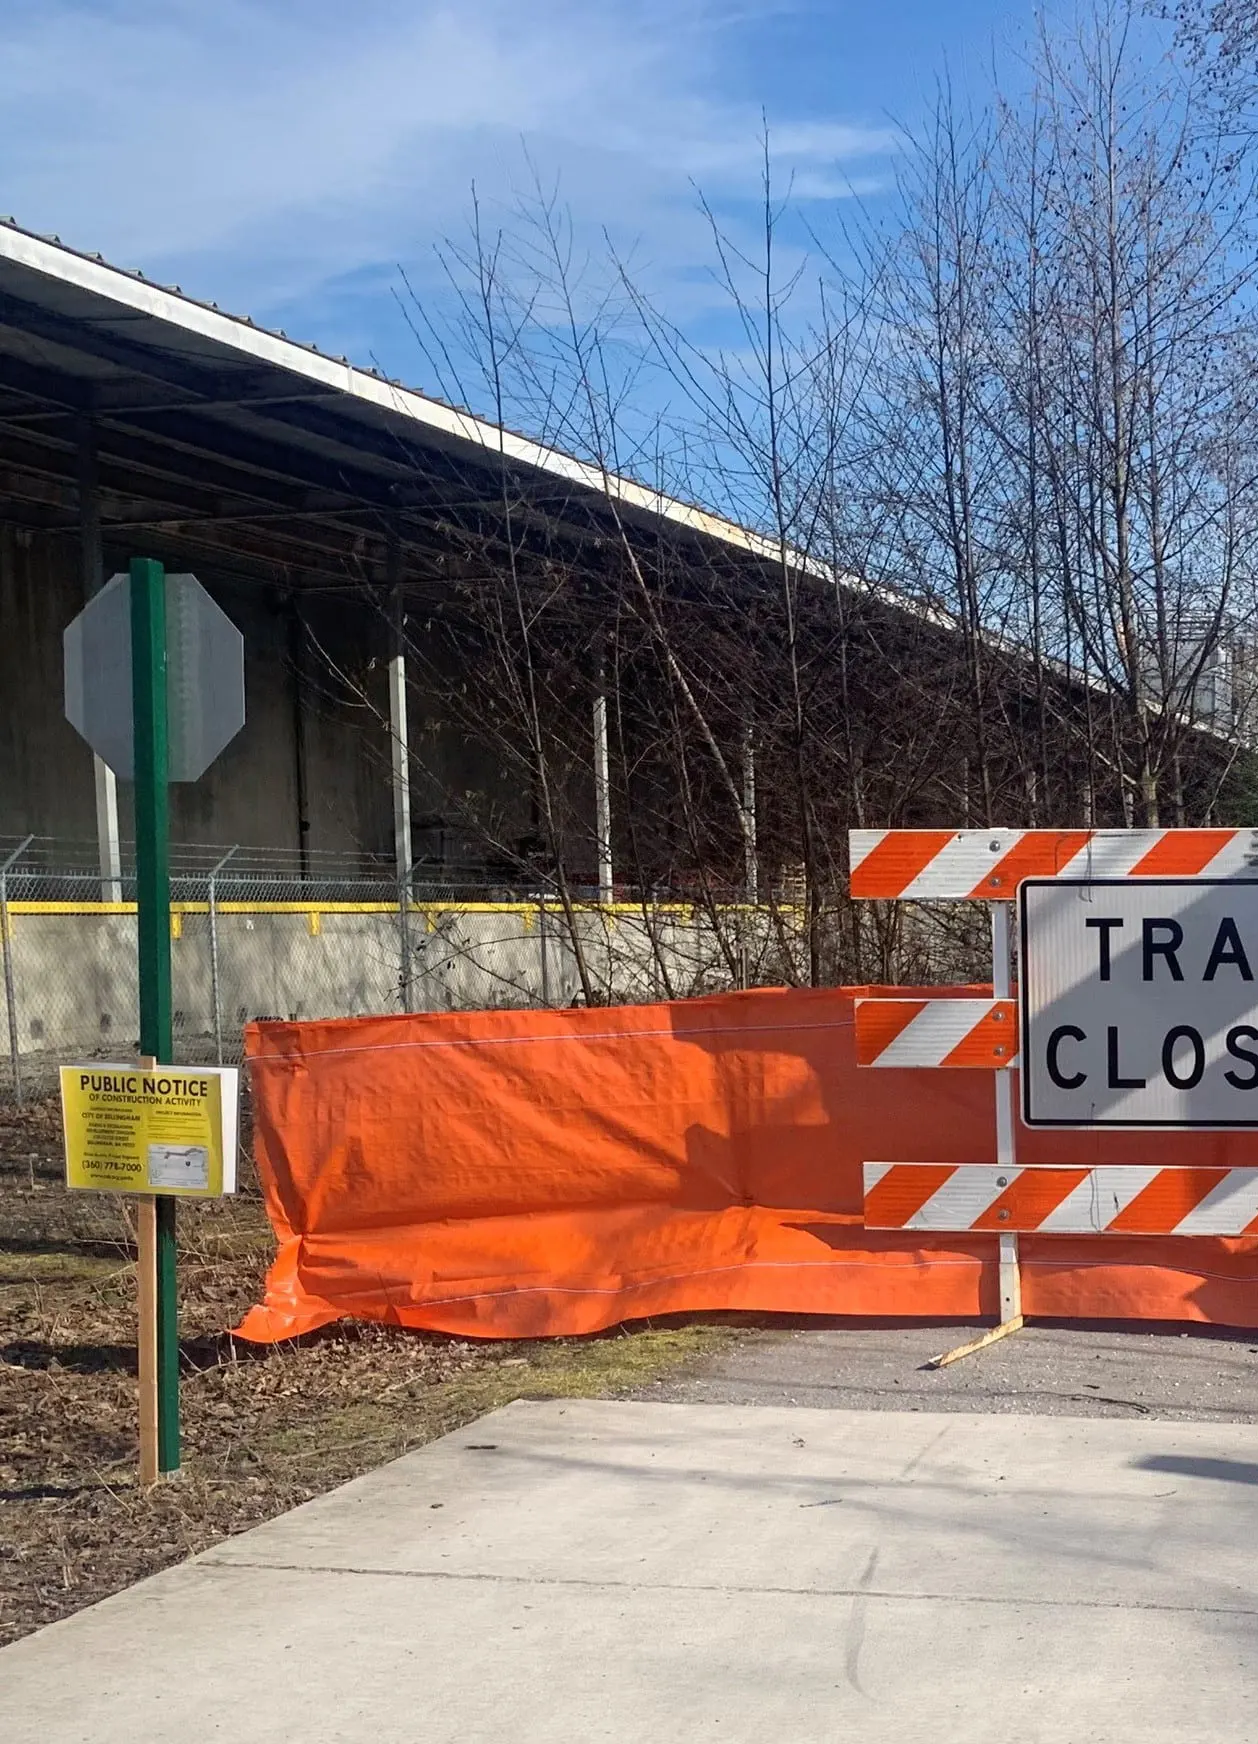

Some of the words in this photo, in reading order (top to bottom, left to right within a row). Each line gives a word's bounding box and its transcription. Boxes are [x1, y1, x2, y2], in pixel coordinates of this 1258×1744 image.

[80, 1075, 137, 1094] PUBLIC
[143, 1078, 208, 1097] NOTICE
[89, 1094, 101, 1102] OF
[102, 1095, 162, 1105] CONSTRUCTION
[165, 1097, 202, 1107] ACTIVITY
